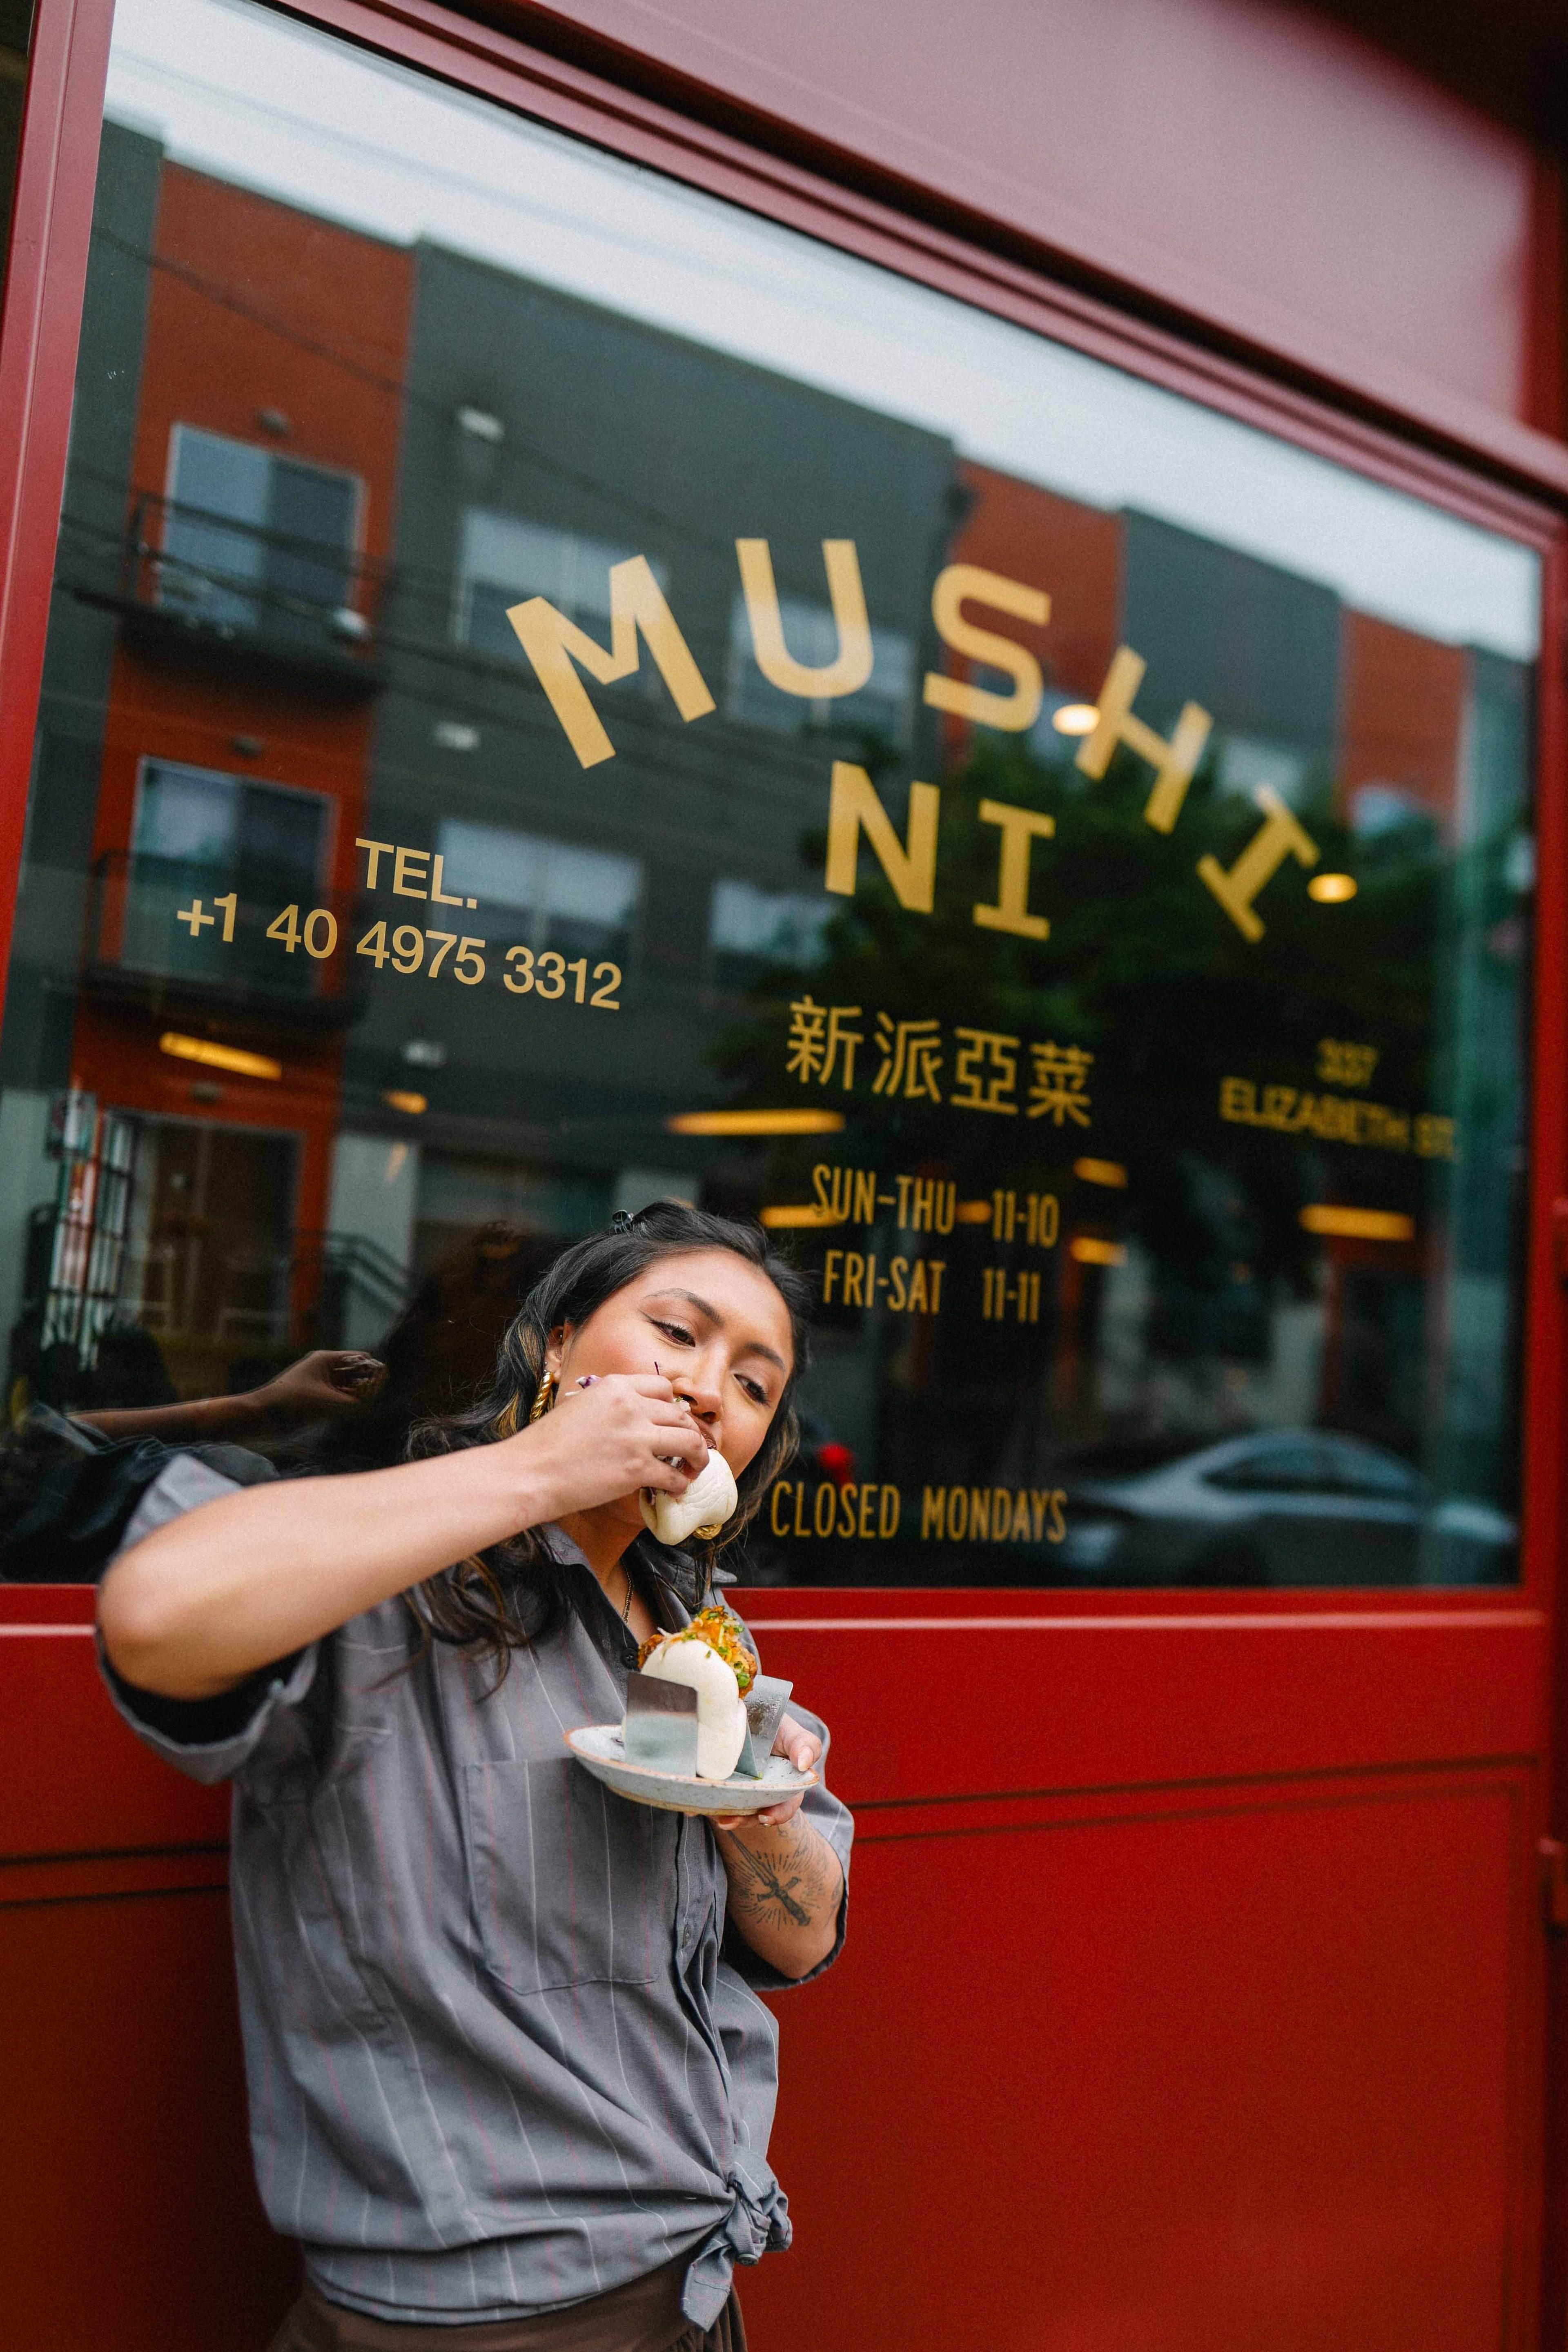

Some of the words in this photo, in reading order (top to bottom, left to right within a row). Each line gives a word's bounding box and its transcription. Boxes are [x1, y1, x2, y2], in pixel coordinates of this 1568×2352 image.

[505, 537, 1320, 943] MUSHI
[355, 837, 477, 909] TEL.
[825, 760, 1056, 941] NI
[177, 893, 238, 942] +1
[266, 904, 338, 959] 40
[356, 921, 486, 985] 4975
[503, 945, 622, 1010] 3312
[785, 994, 1095, 1128] 新派亞菜
[811, 1163, 957, 1235] SUN-THU
[992, 1189, 1060, 1248] 11-10
[823, 1249, 947, 1315] FRI-SAT
[982, 1267, 1041, 1323] 11-11
[771, 1481, 900, 1539] CLOSED
[920, 1485, 1068, 1544] MONDAYS
